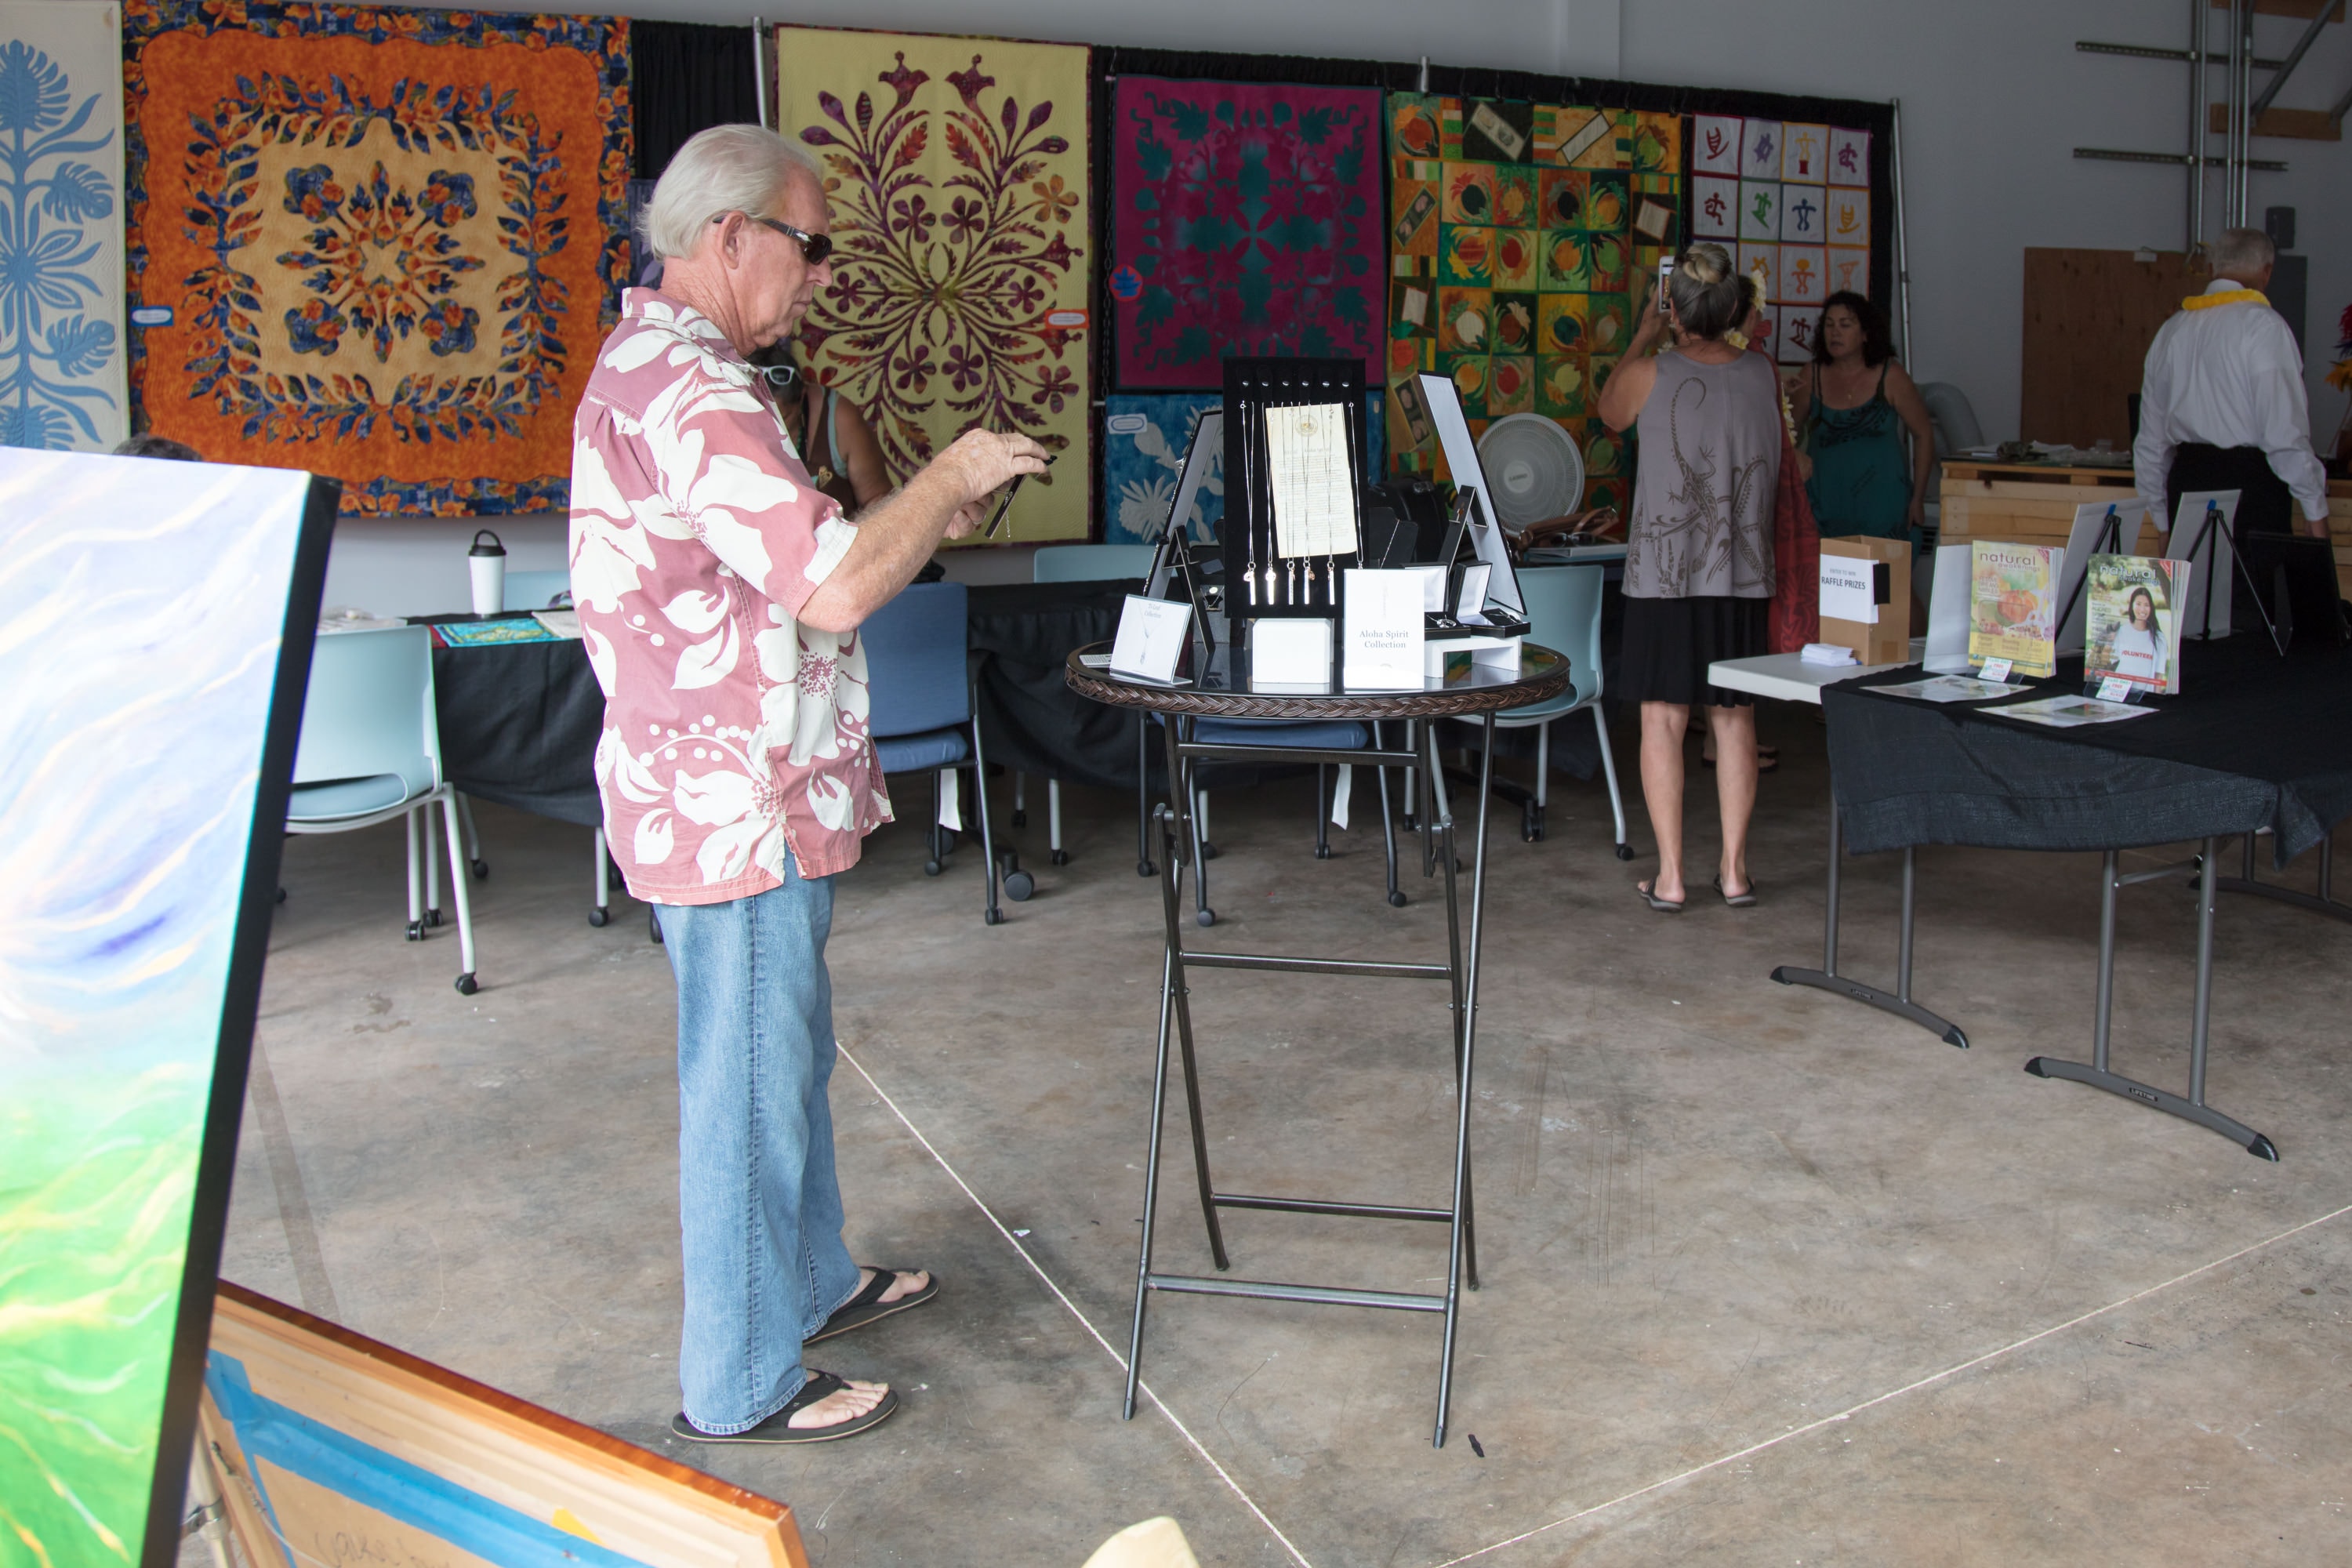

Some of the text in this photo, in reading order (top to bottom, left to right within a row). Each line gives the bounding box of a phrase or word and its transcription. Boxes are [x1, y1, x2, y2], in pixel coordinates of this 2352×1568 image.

[1980, 552, 2036, 566] natural
[1998, 563, 2040, 572] awakenings
[2100, 564, 2157, 579] natural
[1821, 576, 1866, 590] RAFFLE PRIZES
[1359, 630, 1409, 640] Aloha Spirit
[1364, 640, 1406, 649] Collection
[2132, 1088, 2155, 1100] LIFETIME
